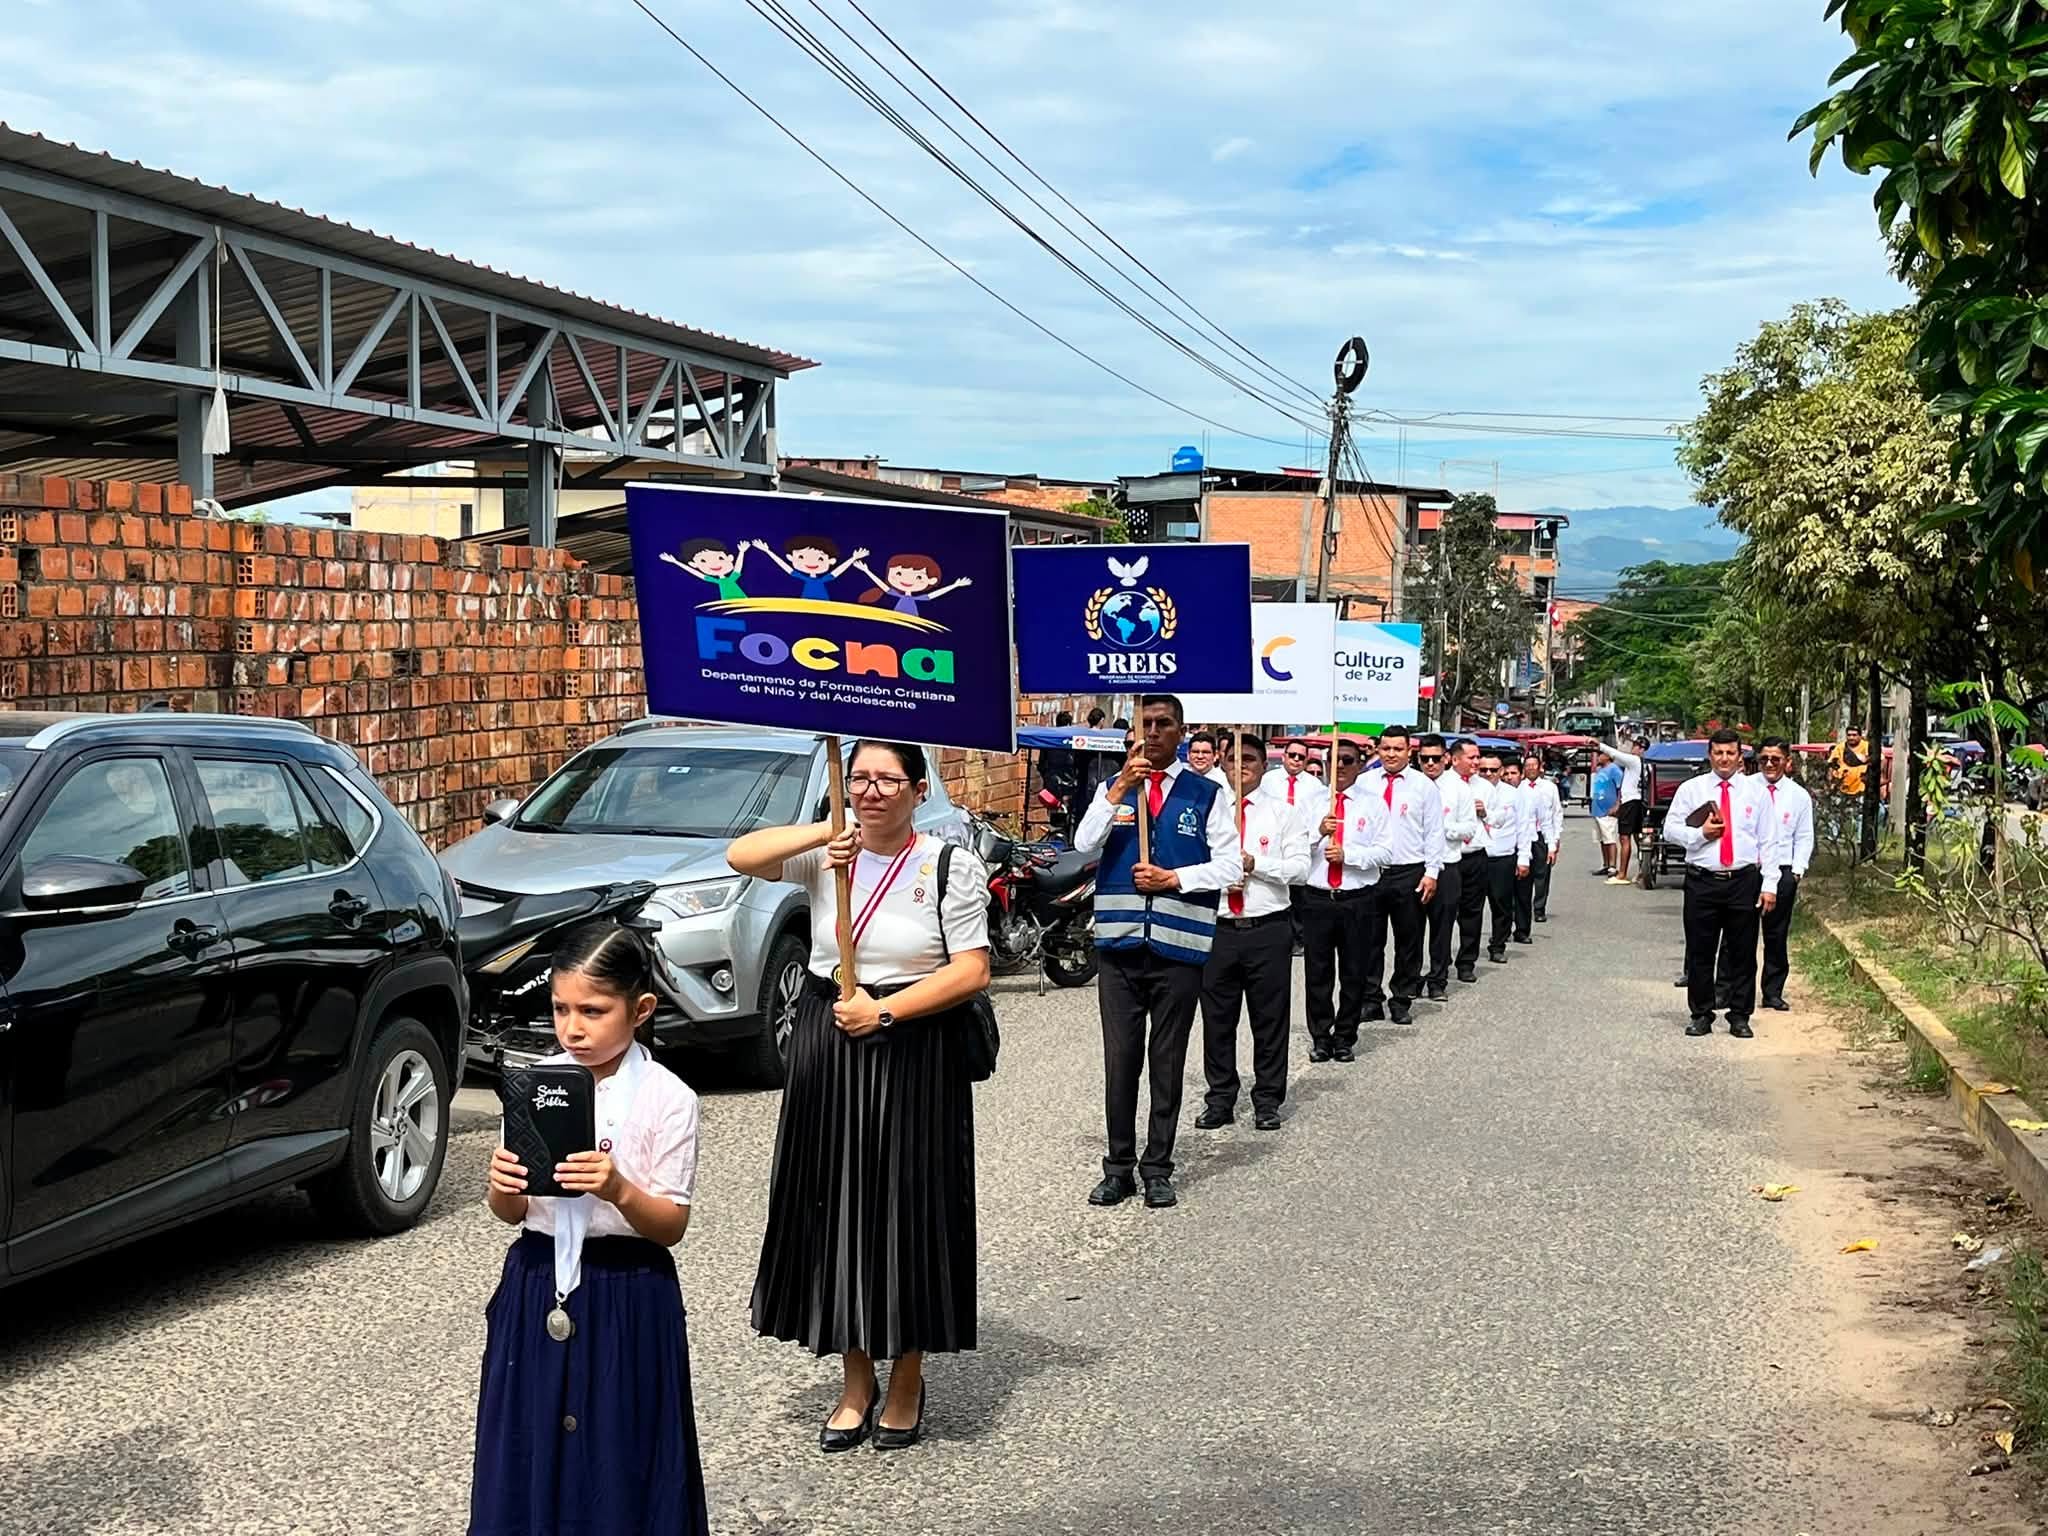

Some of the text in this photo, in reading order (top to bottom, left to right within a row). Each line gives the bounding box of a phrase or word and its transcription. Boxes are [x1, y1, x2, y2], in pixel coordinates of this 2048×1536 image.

[695, 616, 955, 684] Focna
[1252, 636, 1297, 681] C
[1334, 651, 1405, 669] Cultura
[1087, 652, 1178, 674] PREIS
[701, 668, 956, 702] Departamento de Formación Cristiana
[1344, 669, 1392, 682] de Paz
[739, 684, 917, 710] del Niño y del Adolescente
[1342, 693, 1369, 703] Selva
[537, 1085, 569, 1097] Santa
[532, 1096, 570, 1111] Biblia
